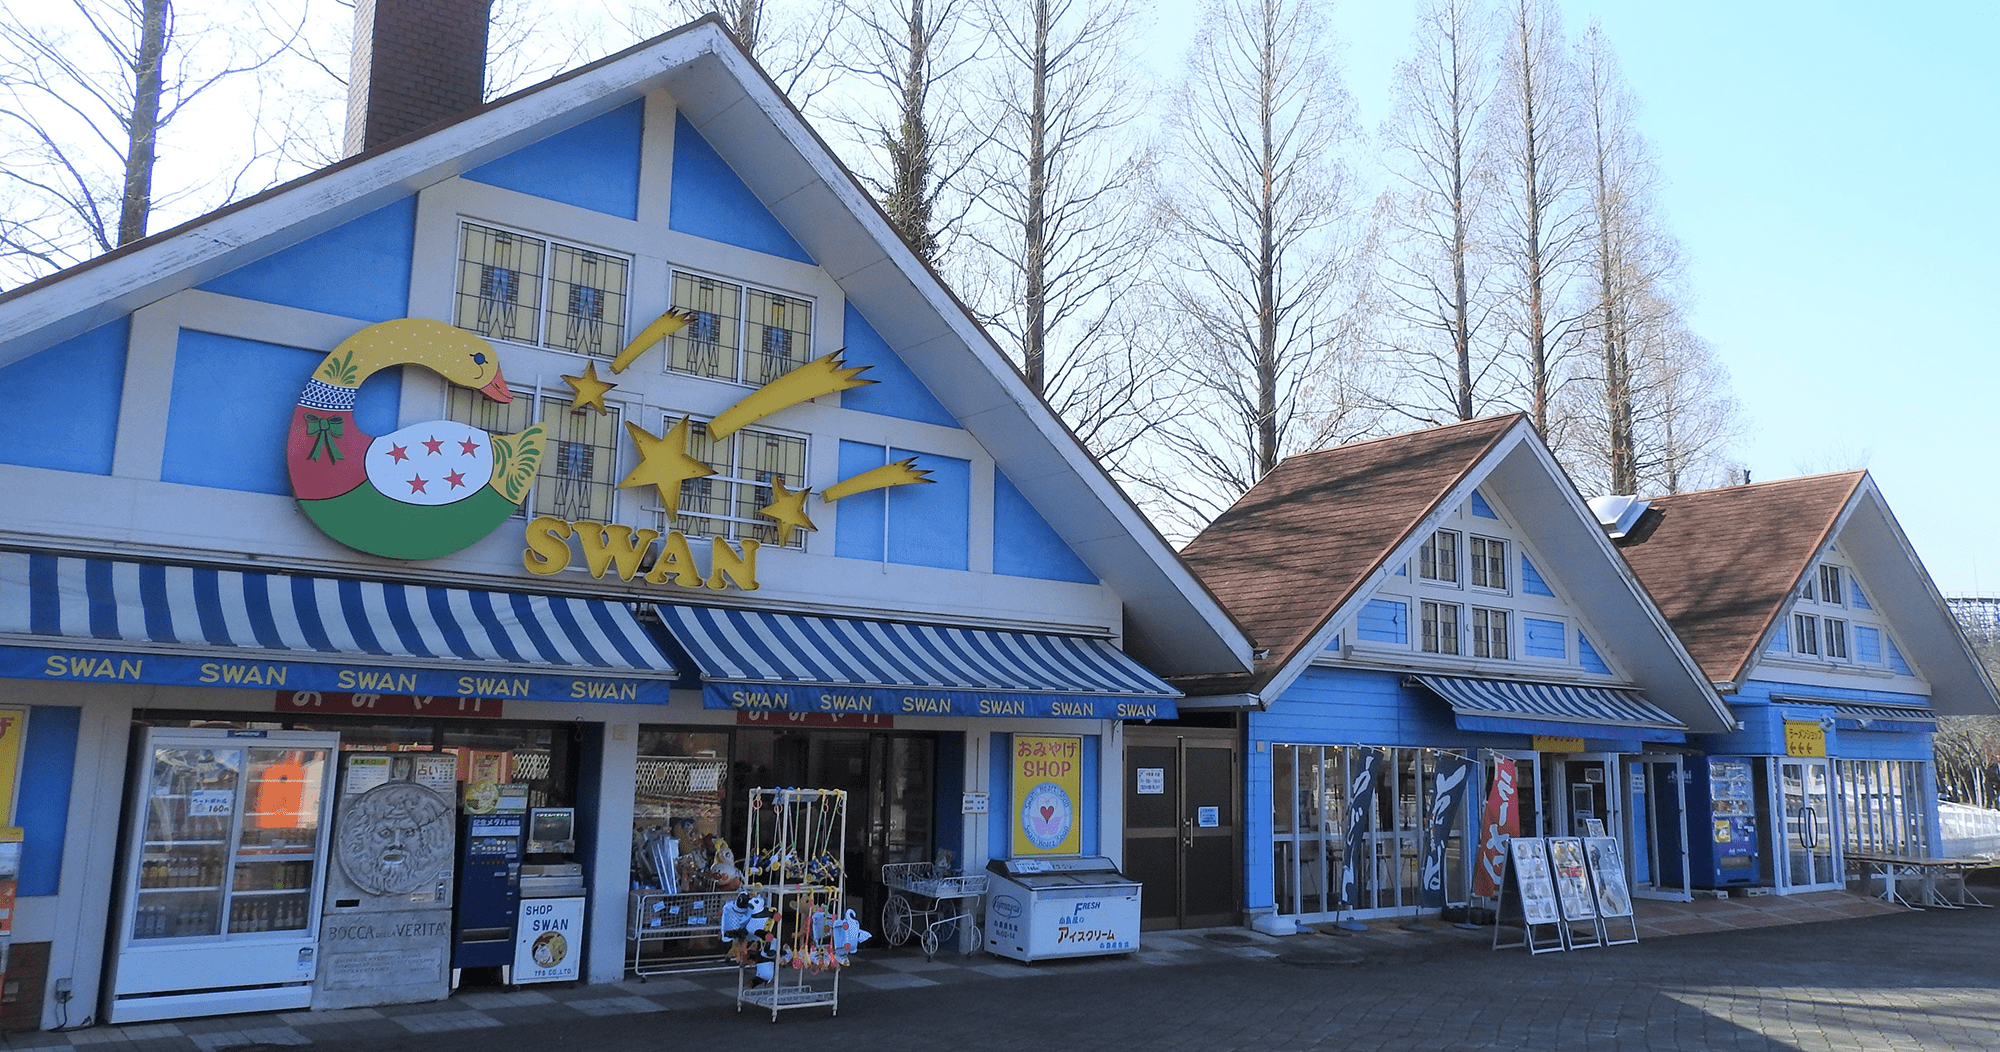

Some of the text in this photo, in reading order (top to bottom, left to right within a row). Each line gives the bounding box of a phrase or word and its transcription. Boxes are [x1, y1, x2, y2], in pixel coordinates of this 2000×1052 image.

[524, 516, 761, 590] SWAN
[45, 655, 142, 680] SWAN
[199, 662, 287, 686] SWAN
[337, 670, 416, 692] SWAN
[457, 677, 530, 697] SWAN
[570, 681, 637, 700] SWAN
[732, 691, 788, 709] SWAN
[820, 694, 872, 711] SWAN
[902, 697, 951, 713] SWAN
[979, 699, 1025, 715] SWAN
[1051, 701, 1093, 716] SWAN
[1117, 703, 1157, 717] SWAN
[1018, 741, 1077, 757] おみやげ
[1023, 760, 1071, 777] SHOP
[1025, 790, 1037, 810] Swan
[1039, 784, 1057, 793] Heart
[1025, 824, 1037, 843] Swan
[1039, 839, 1056, 848] Heart
[525, 904, 553, 916] SHOP
[1074, 901, 1101, 916] FRESH
[328, 924, 375, 941] BOCCA
[532, 918, 569, 931] SWAN
[1057, 926, 1115, 944] アイスクリーム
